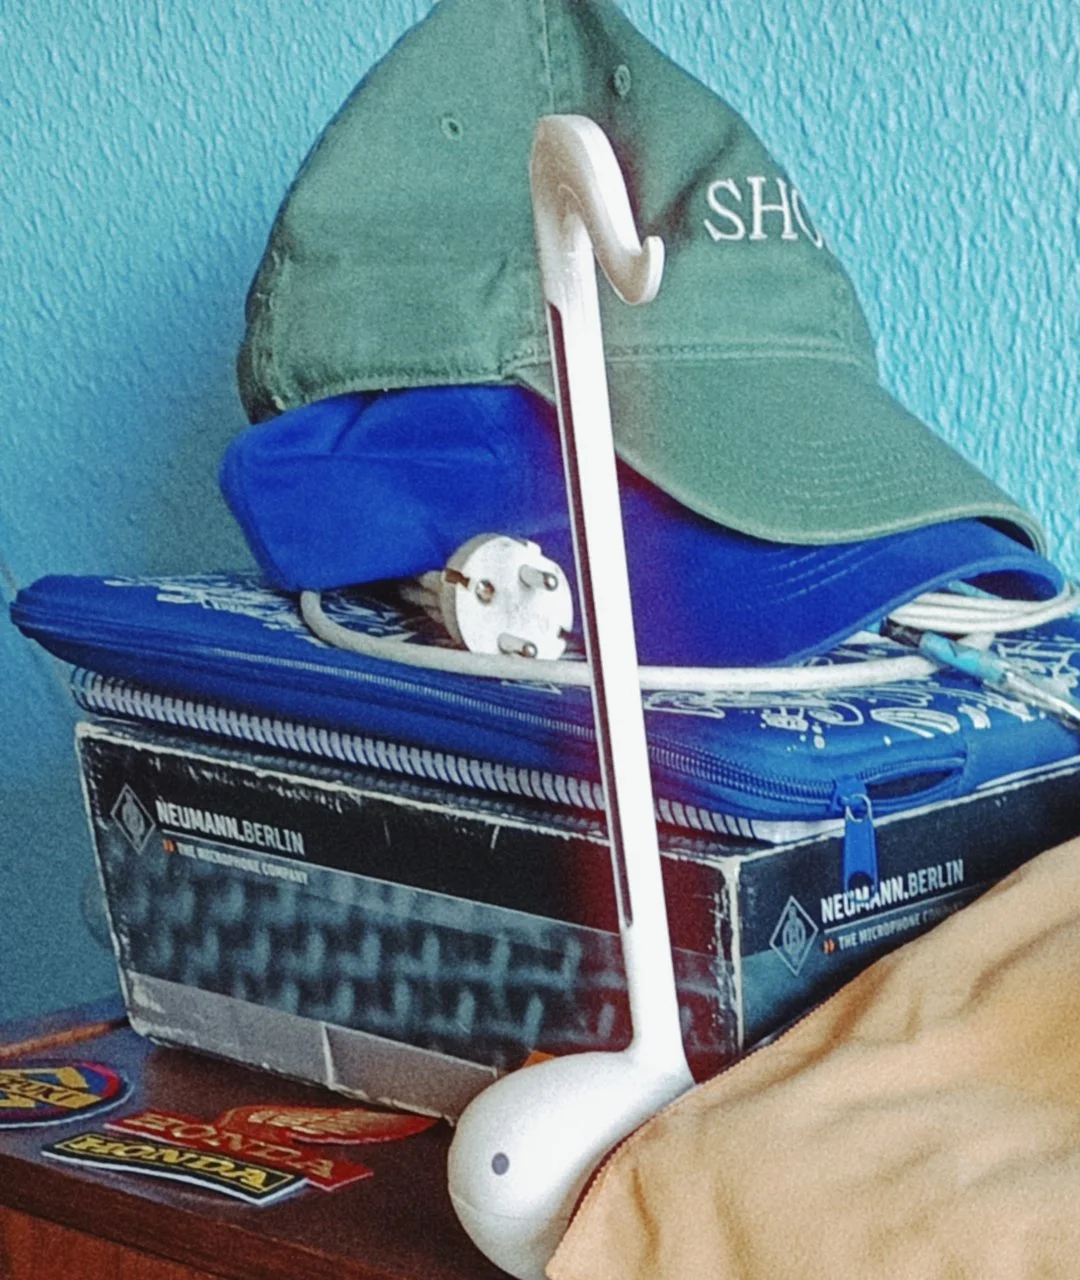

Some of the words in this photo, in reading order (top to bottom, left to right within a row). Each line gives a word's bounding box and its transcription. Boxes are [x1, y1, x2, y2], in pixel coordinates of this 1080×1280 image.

[156, 798, 304, 855] NEUMANN.BERLIN
[838, 933, 858, 950] THE
[858, 914, 920, 946] MICROPHONE
[70, 1137, 268, 1189] HONDA
[123, 1113, 334, 1179] HONDA
